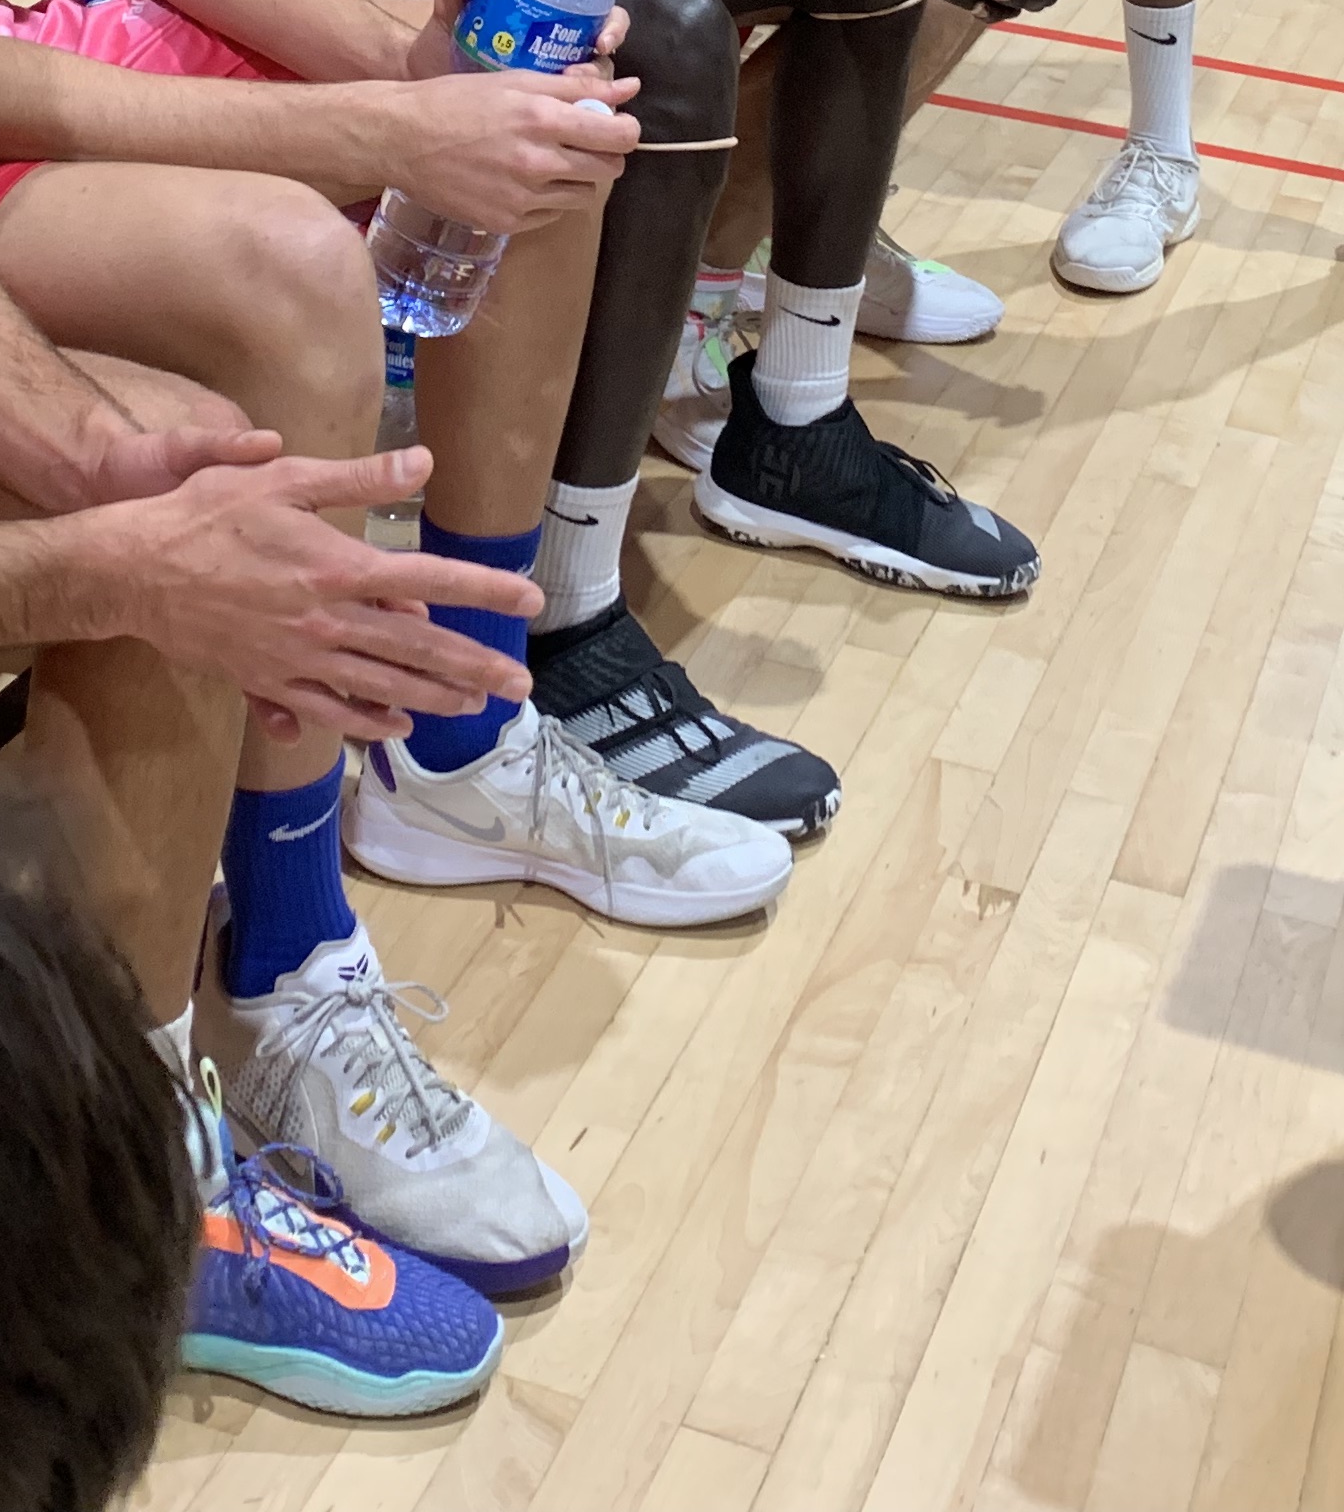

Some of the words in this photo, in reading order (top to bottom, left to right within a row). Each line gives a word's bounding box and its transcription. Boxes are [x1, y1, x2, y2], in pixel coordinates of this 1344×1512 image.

[496, 34, 513, 49] 1,5
[549, 22, 582, 44] Font
[528, 35, 584, 61] Agudes
